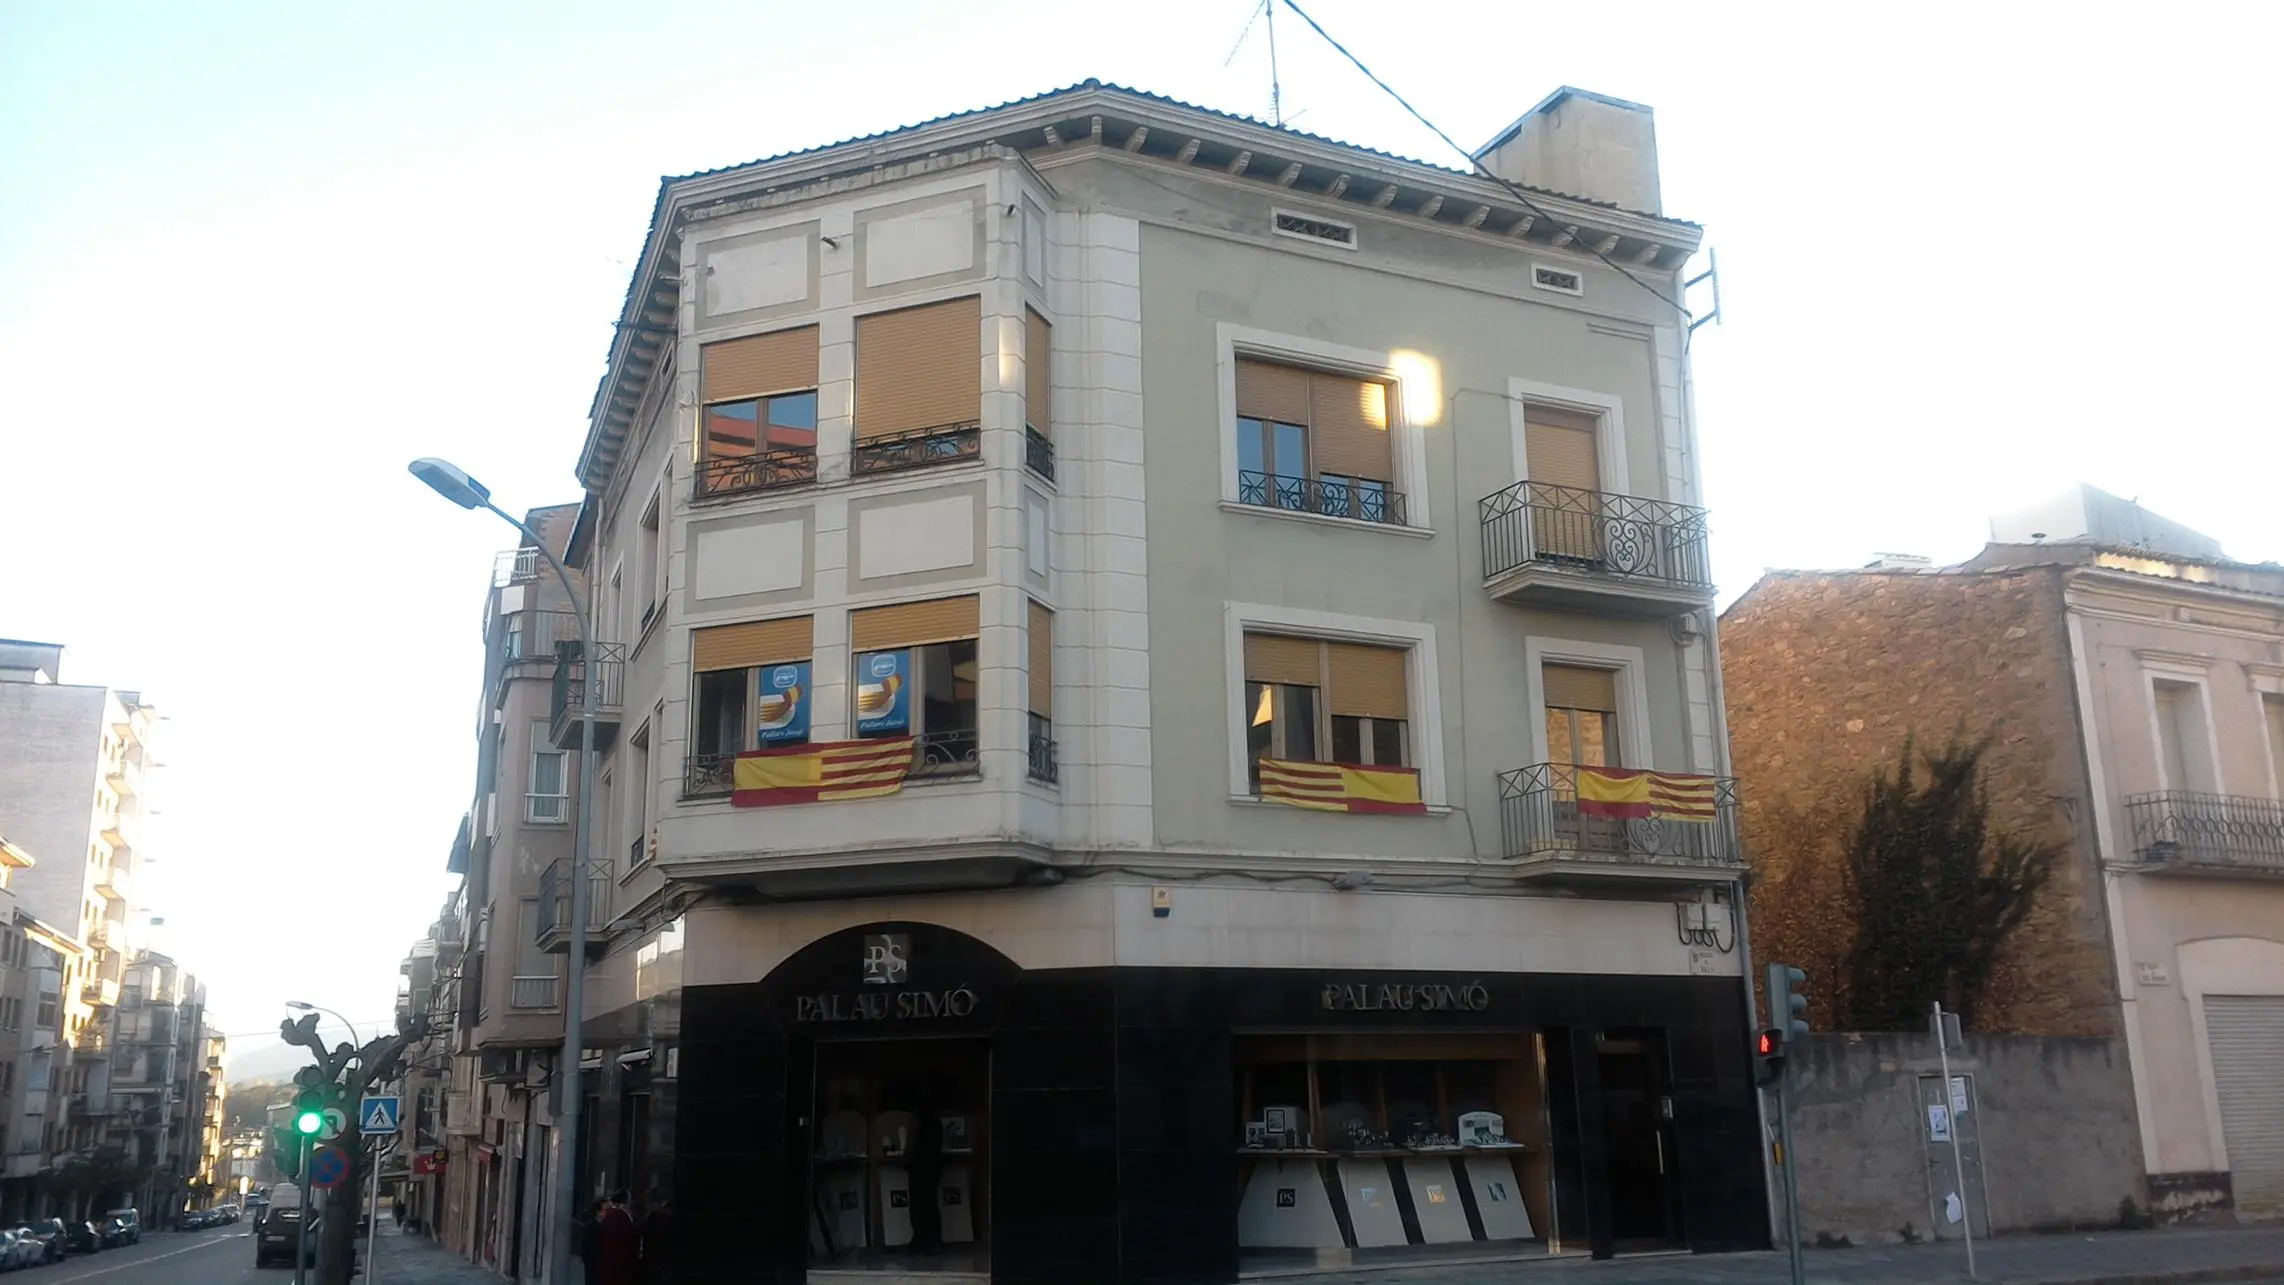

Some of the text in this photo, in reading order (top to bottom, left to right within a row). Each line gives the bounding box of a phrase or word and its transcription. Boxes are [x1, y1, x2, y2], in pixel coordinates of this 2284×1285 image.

[796, 983, 977, 1021] PALAU SIMÓ
[1322, 978, 1490, 1011] PALAU SIMÓ
[1279, 1190, 1295, 1206] PS
